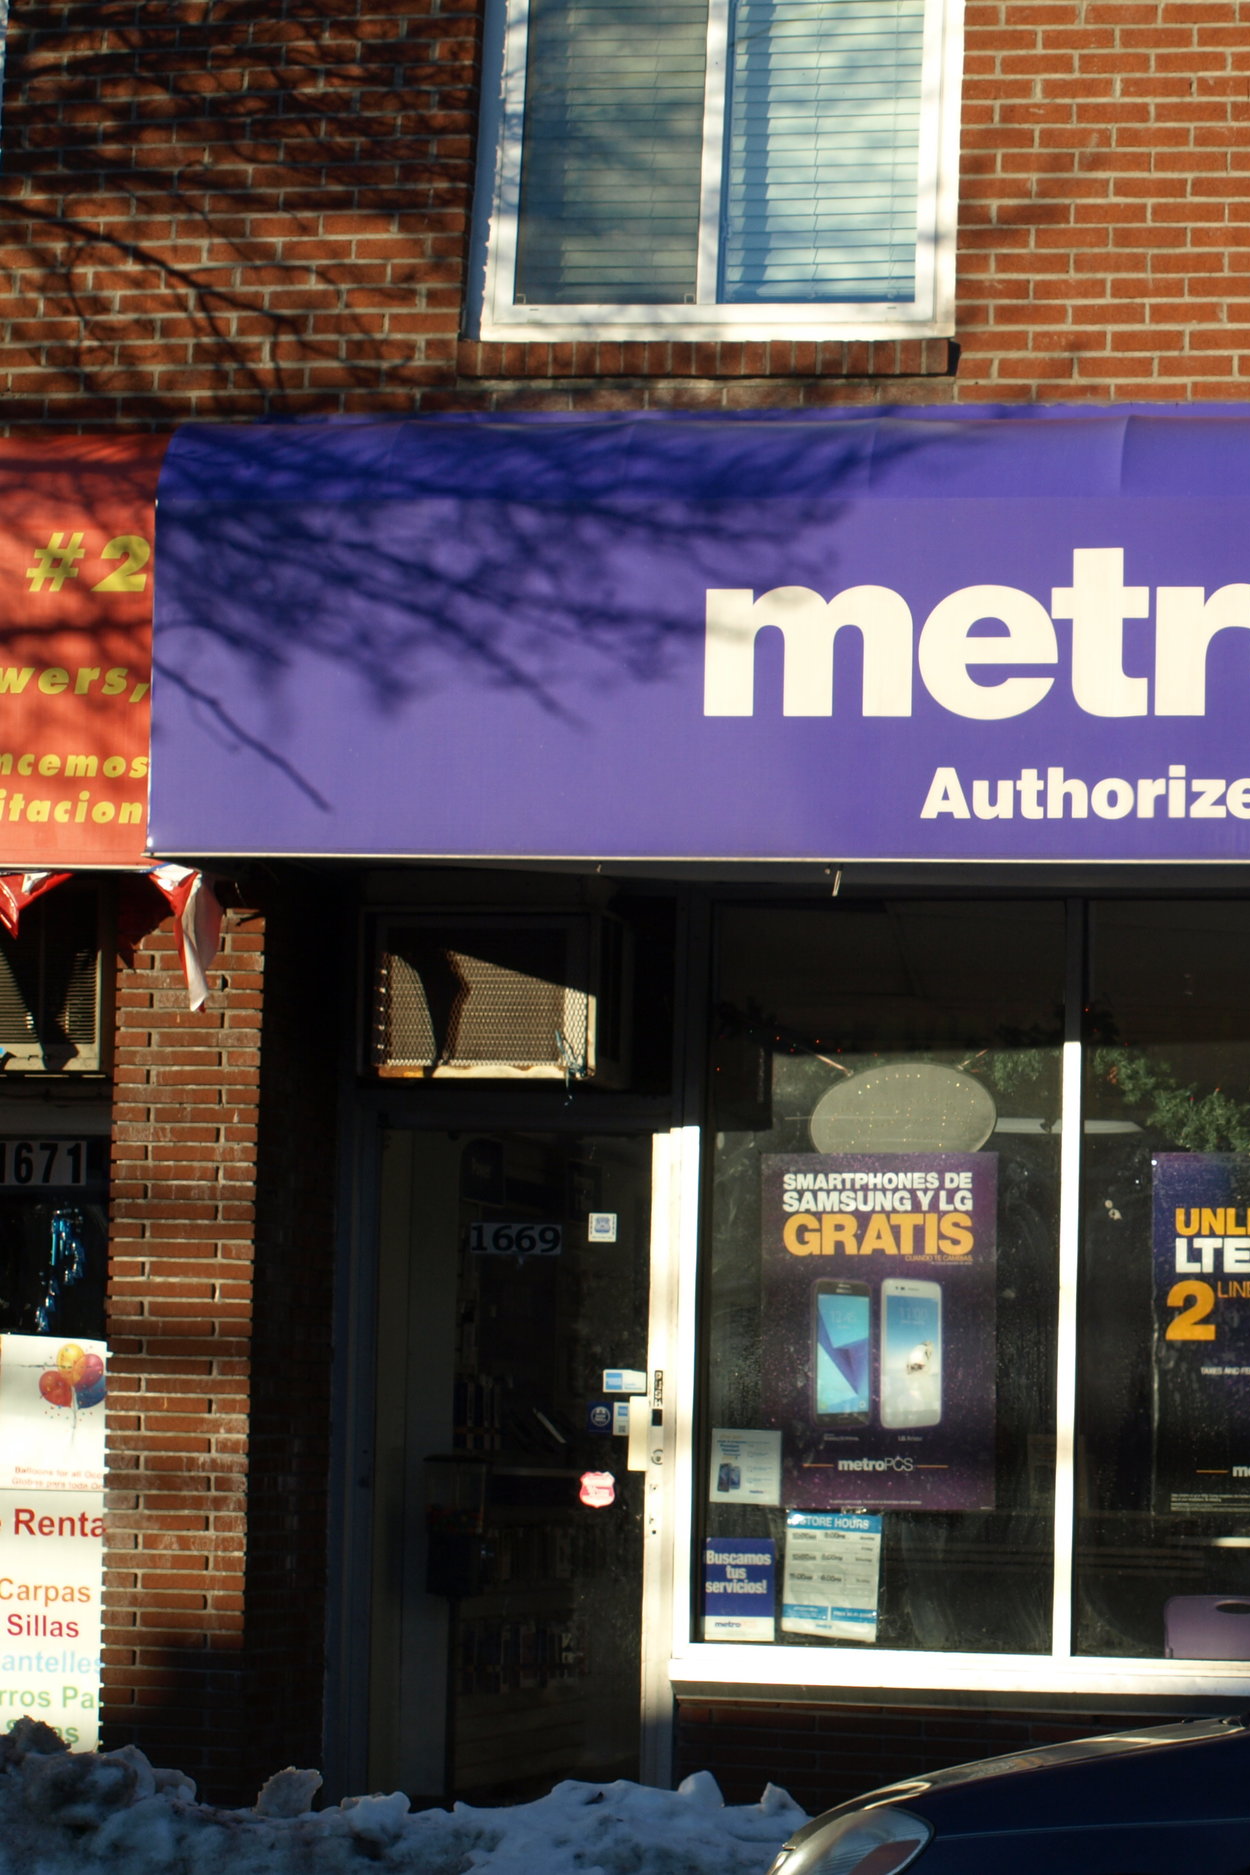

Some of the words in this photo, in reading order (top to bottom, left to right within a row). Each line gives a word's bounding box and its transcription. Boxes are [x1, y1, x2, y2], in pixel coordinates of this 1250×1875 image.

[783, 1172, 940, 1190] SMARTPHONES
[944, 1172, 972, 1188] DE
[782, 1190, 912, 1212] SAMSUNG
[916, 1190, 935, 1211] Y
[939, 1190, 973, 1211] LG
[472, 1224, 561, 1253] 1669
[782, 1212, 975, 1257] GRATIS
[1165, 1279, 1216, 1341] 2
[838, 1457, 914, 1472] metroPCS
[834, 1517, 870, 1530] HOURS
[706, 1549, 771, 1565] Buscamos
[726, 1565, 747, 1579] tus
[0, 1577, 91, 1607] Carpas
[705, 1579, 768, 1594] servicios!
[7, 1613, 79, 1638] Sillas
